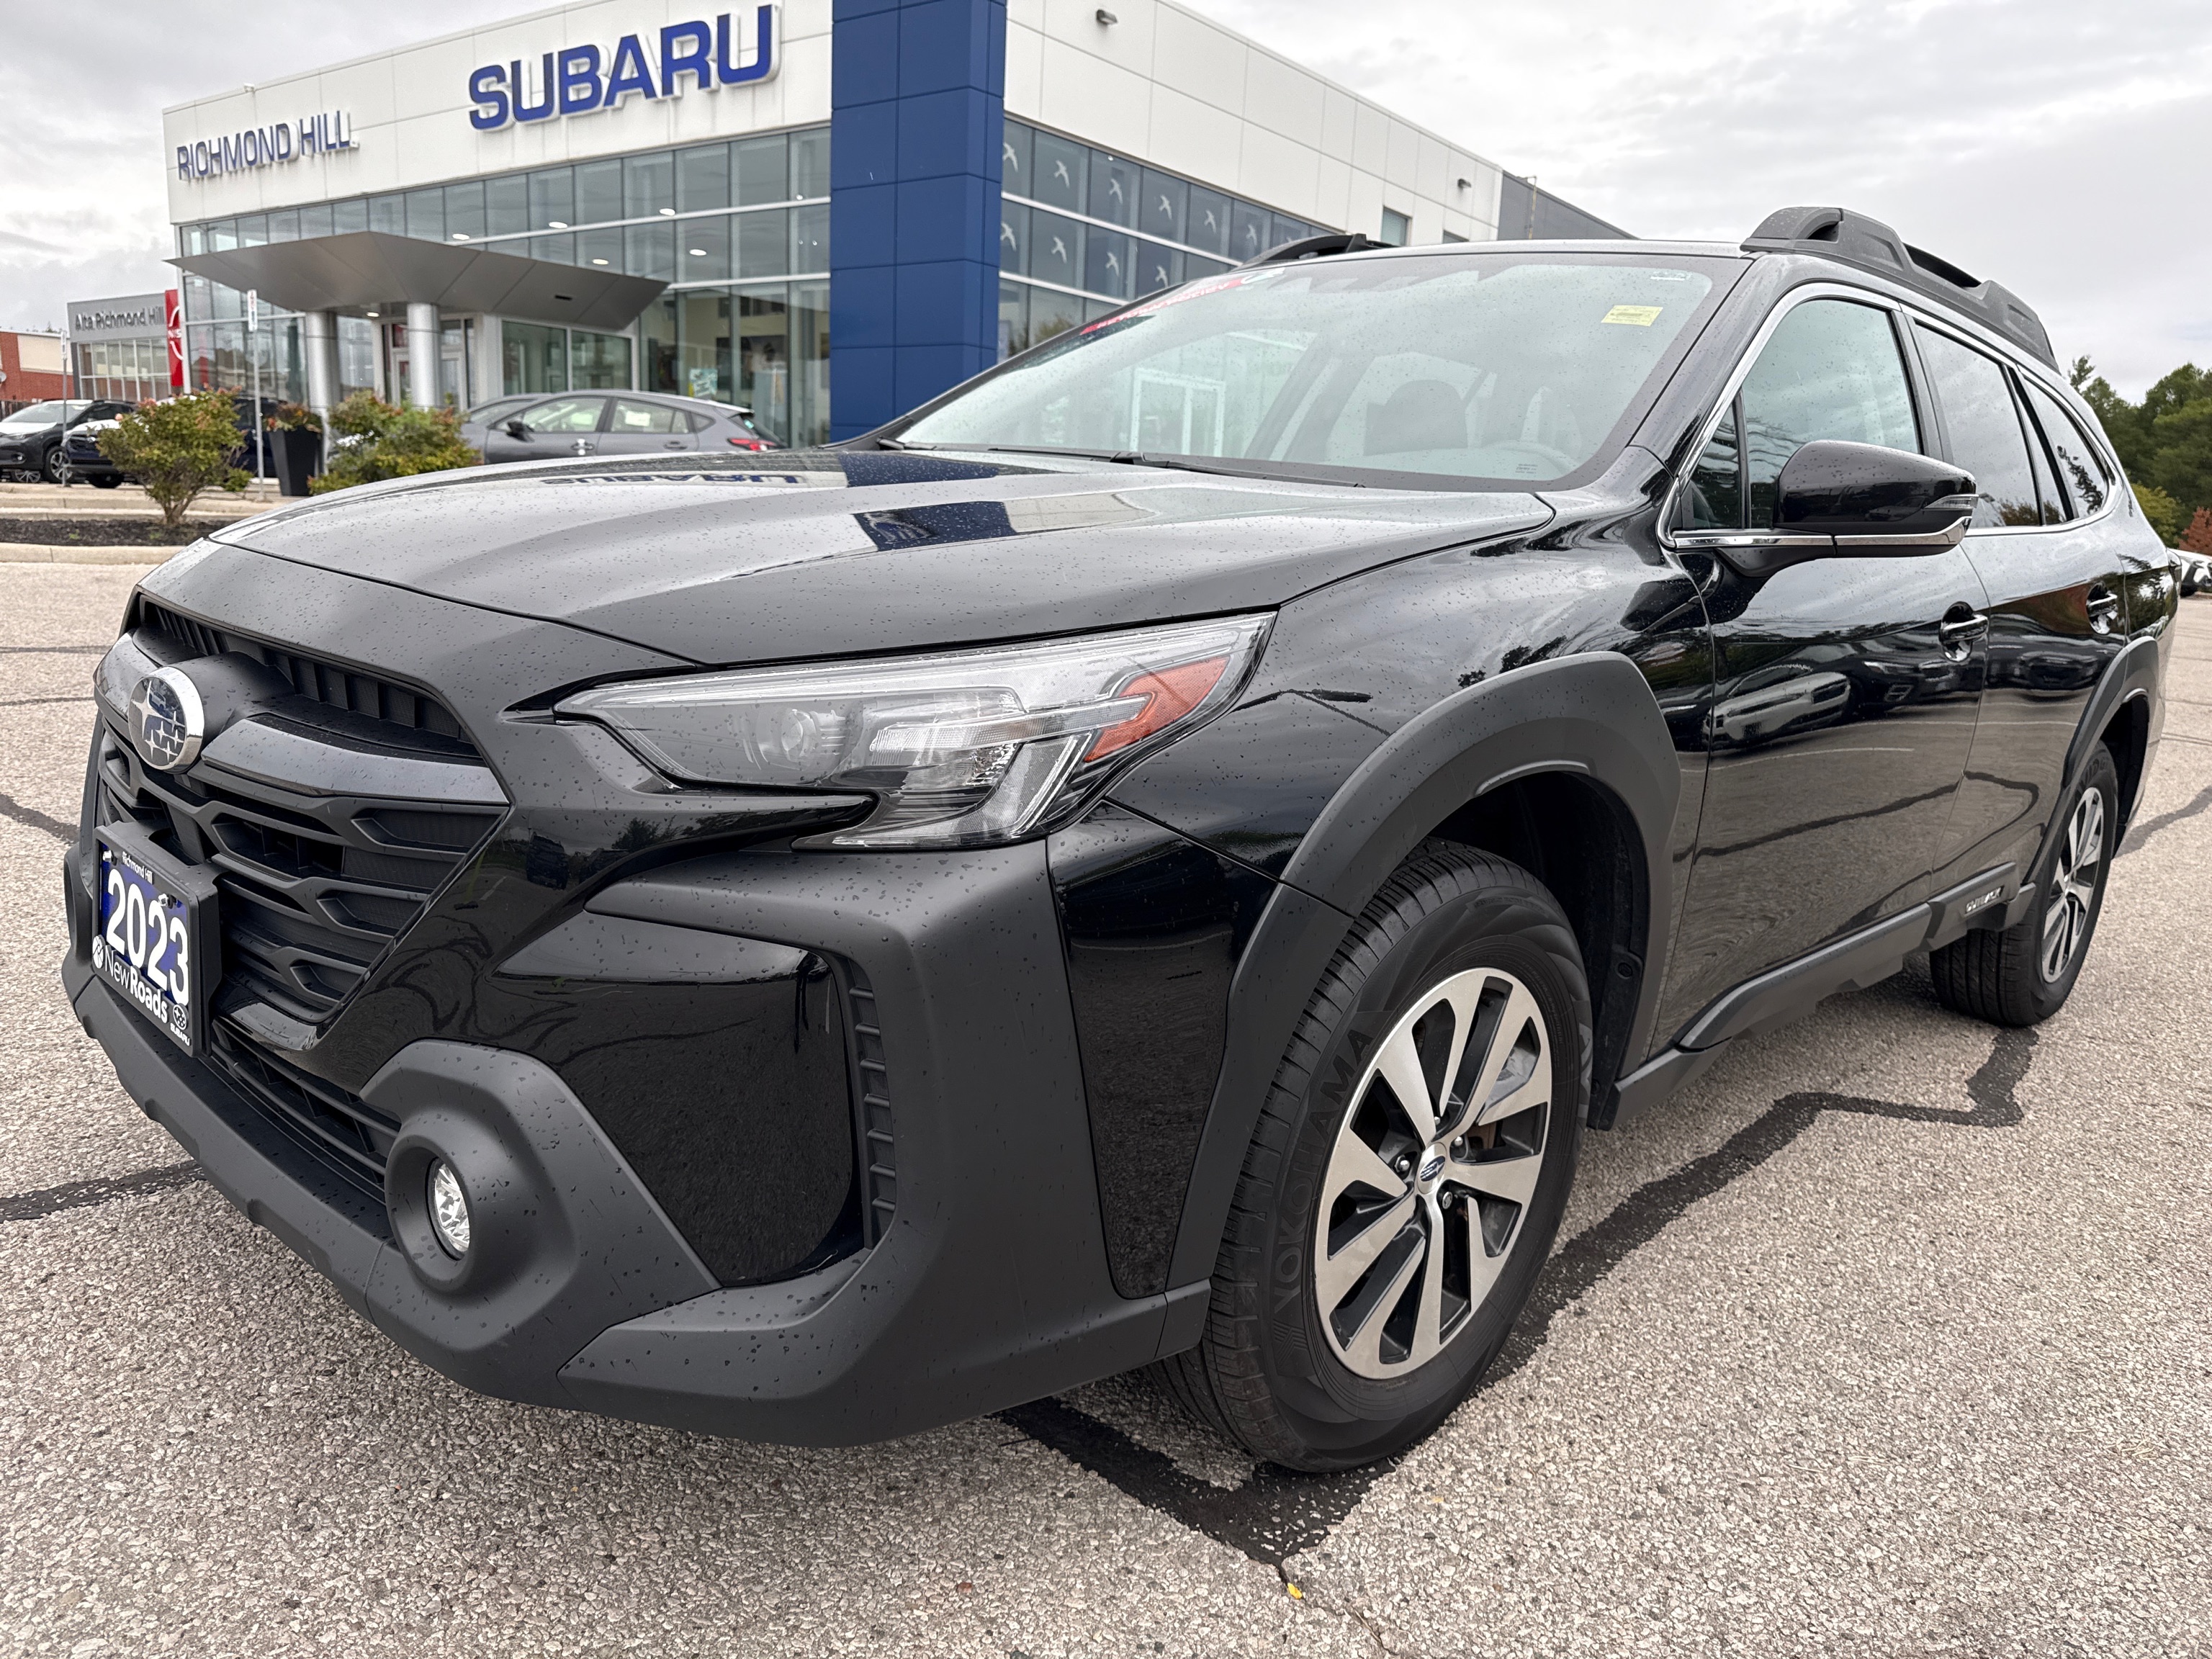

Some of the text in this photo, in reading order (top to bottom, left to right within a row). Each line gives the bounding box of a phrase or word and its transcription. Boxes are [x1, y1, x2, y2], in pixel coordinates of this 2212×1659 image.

[469, 4, 775, 130] SUBARU
[177, 110, 351, 180] RICHMOND HILL
[75, 306, 165, 331] Alta Richmond Hill
[122, 850, 145, 878] Richmond
[107, 869, 189, 1006] 2023
[1274, 1029, 1375, 1314] YOKOHAMA
